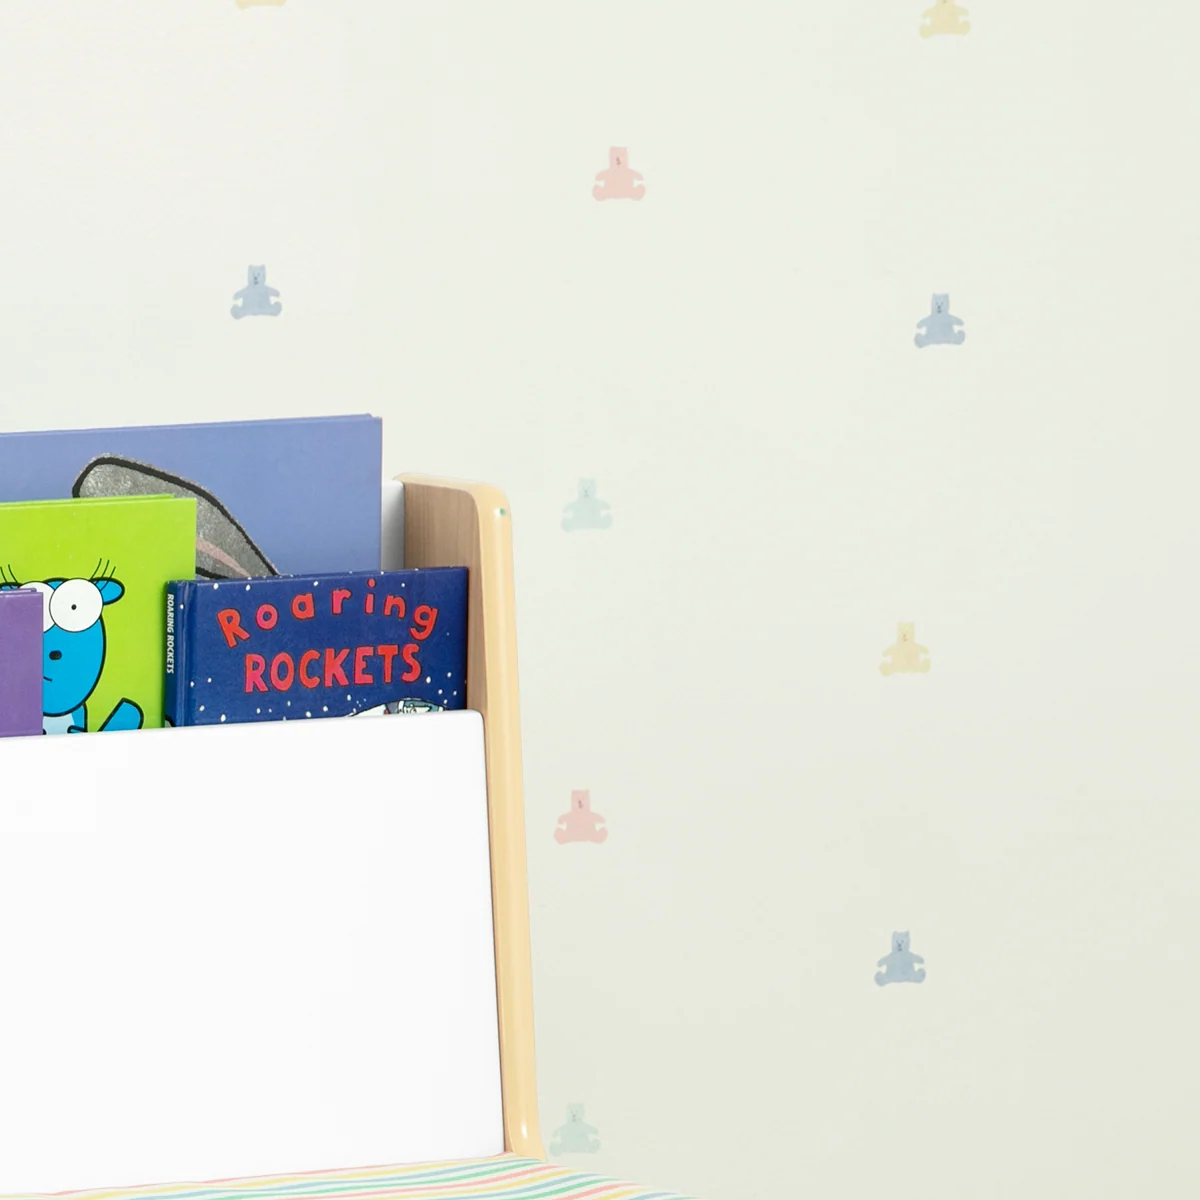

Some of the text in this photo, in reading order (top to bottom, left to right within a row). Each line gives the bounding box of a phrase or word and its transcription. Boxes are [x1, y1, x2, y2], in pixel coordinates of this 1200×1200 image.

[166, 593, 175, 674] ROARING ROCKETS
[217, 579, 438, 650] Roaring
[244, 642, 422, 694] ROCKETS
